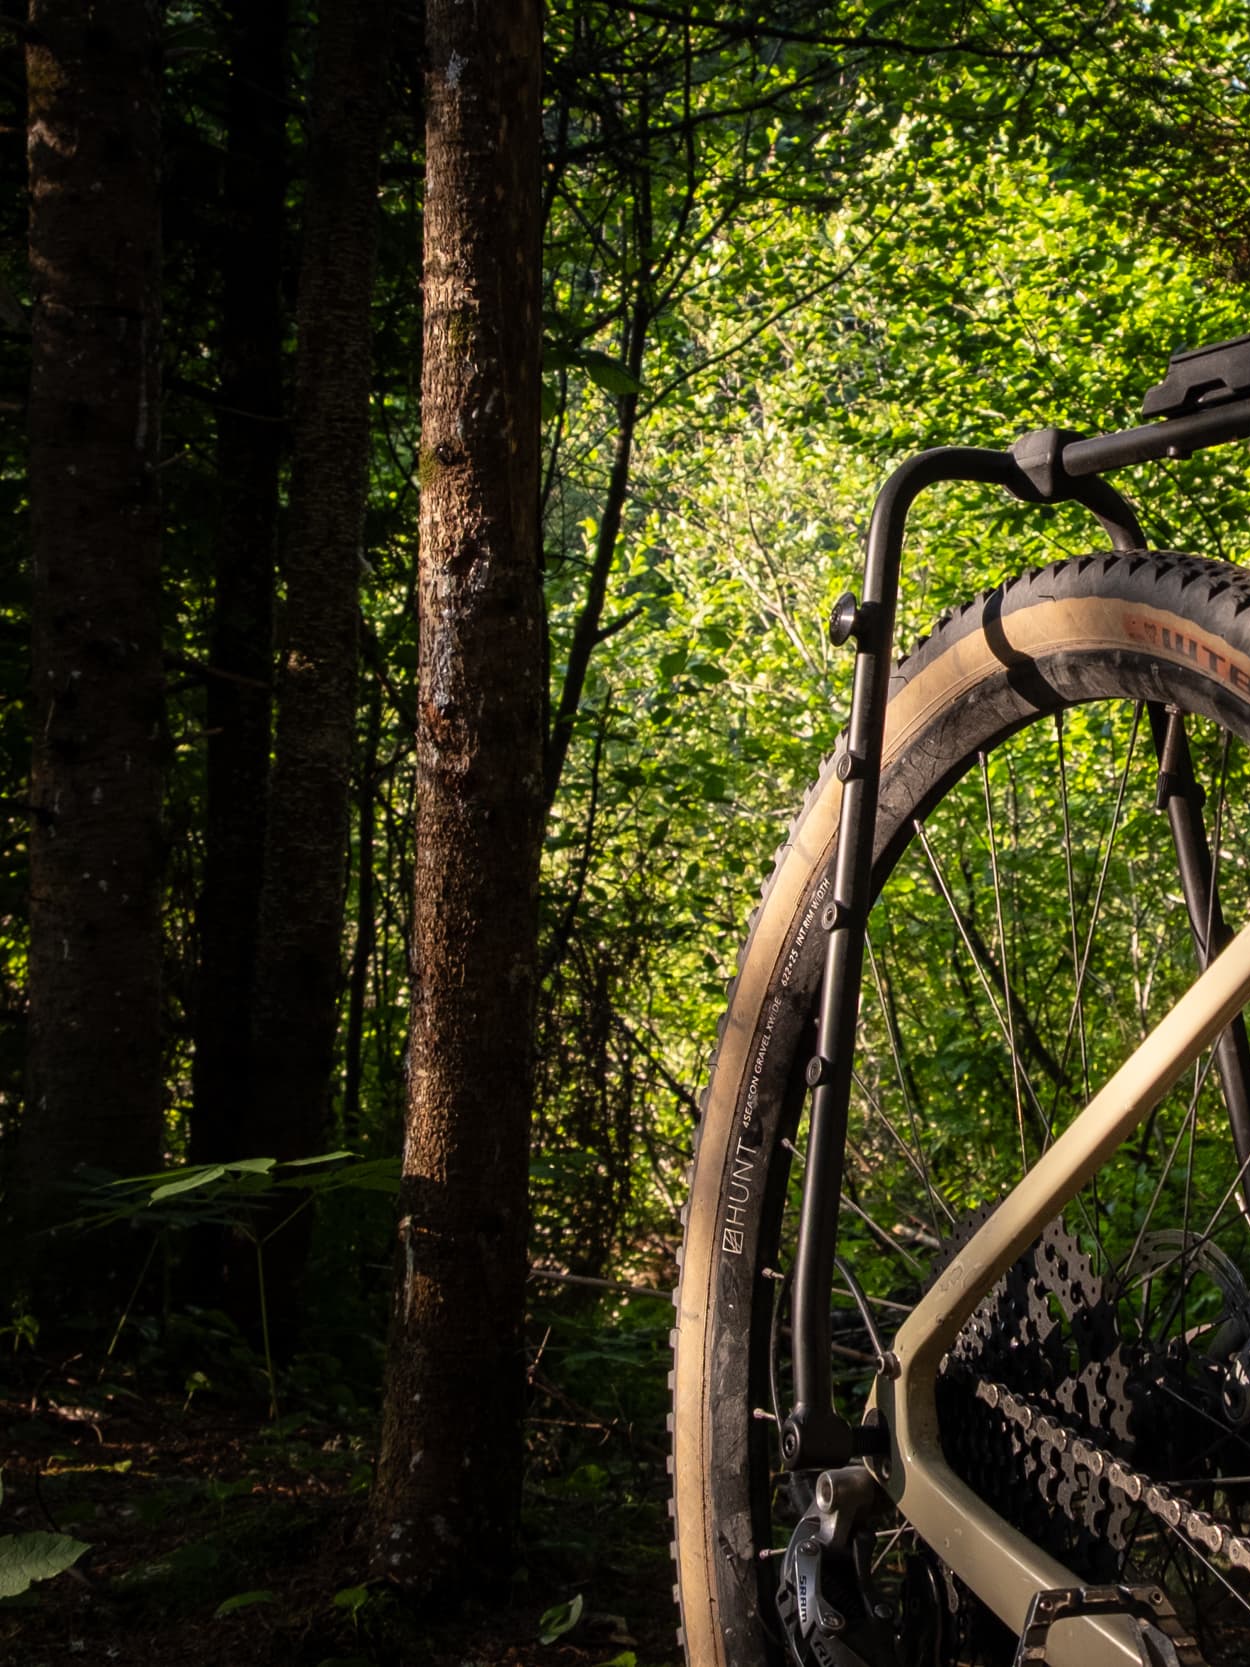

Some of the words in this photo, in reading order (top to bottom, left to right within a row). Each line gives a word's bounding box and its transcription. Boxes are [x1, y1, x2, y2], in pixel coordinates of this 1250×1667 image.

[742, 1076, 760, 1129] 4SEASON
[754, 1031, 771, 1074] GRAVEL
[766, 996, 782, 1032] XWIDE
[811, 878, 831, 911] WIDTH
[725, 1135, 757, 1226] HUNT
[799, 1575, 808, 1623] SRAM
